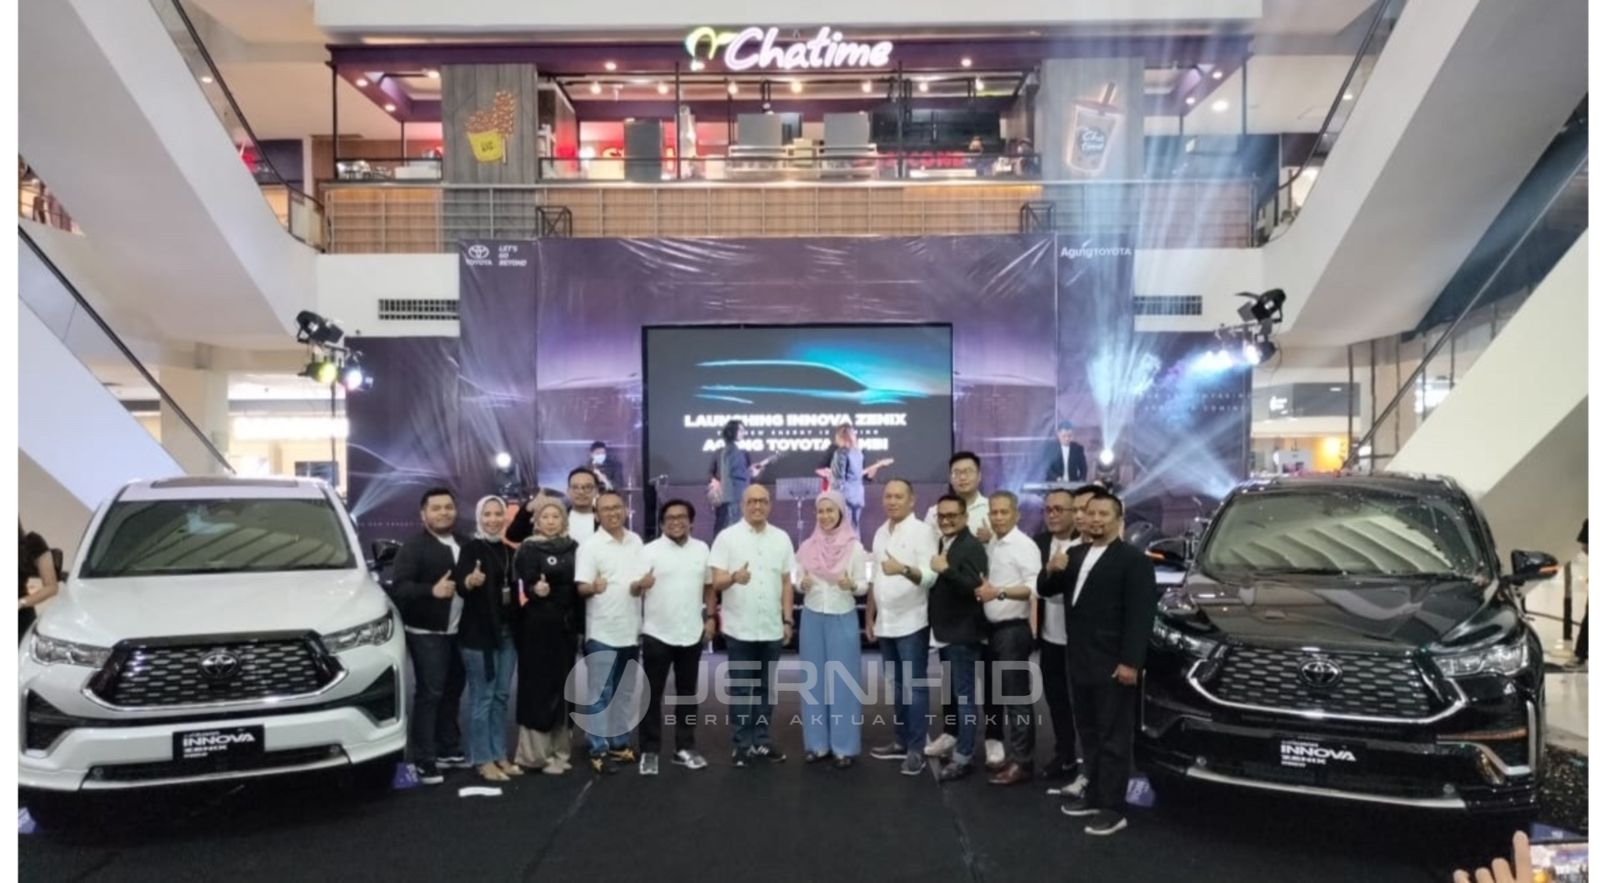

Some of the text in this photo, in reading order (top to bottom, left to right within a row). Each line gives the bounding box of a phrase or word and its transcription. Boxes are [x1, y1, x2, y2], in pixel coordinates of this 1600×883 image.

[724, 26, 893, 70] Chatime
[786, 413, 852, 427] INNOVA
[855, 413, 907, 426] ZENIX
[703, 438, 764, 451] AGNG
[766, 438, 831, 451] TOYOTA
[183, 733, 255, 747] INNOVA
[1281, 745, 1357, 762] INNOVA
